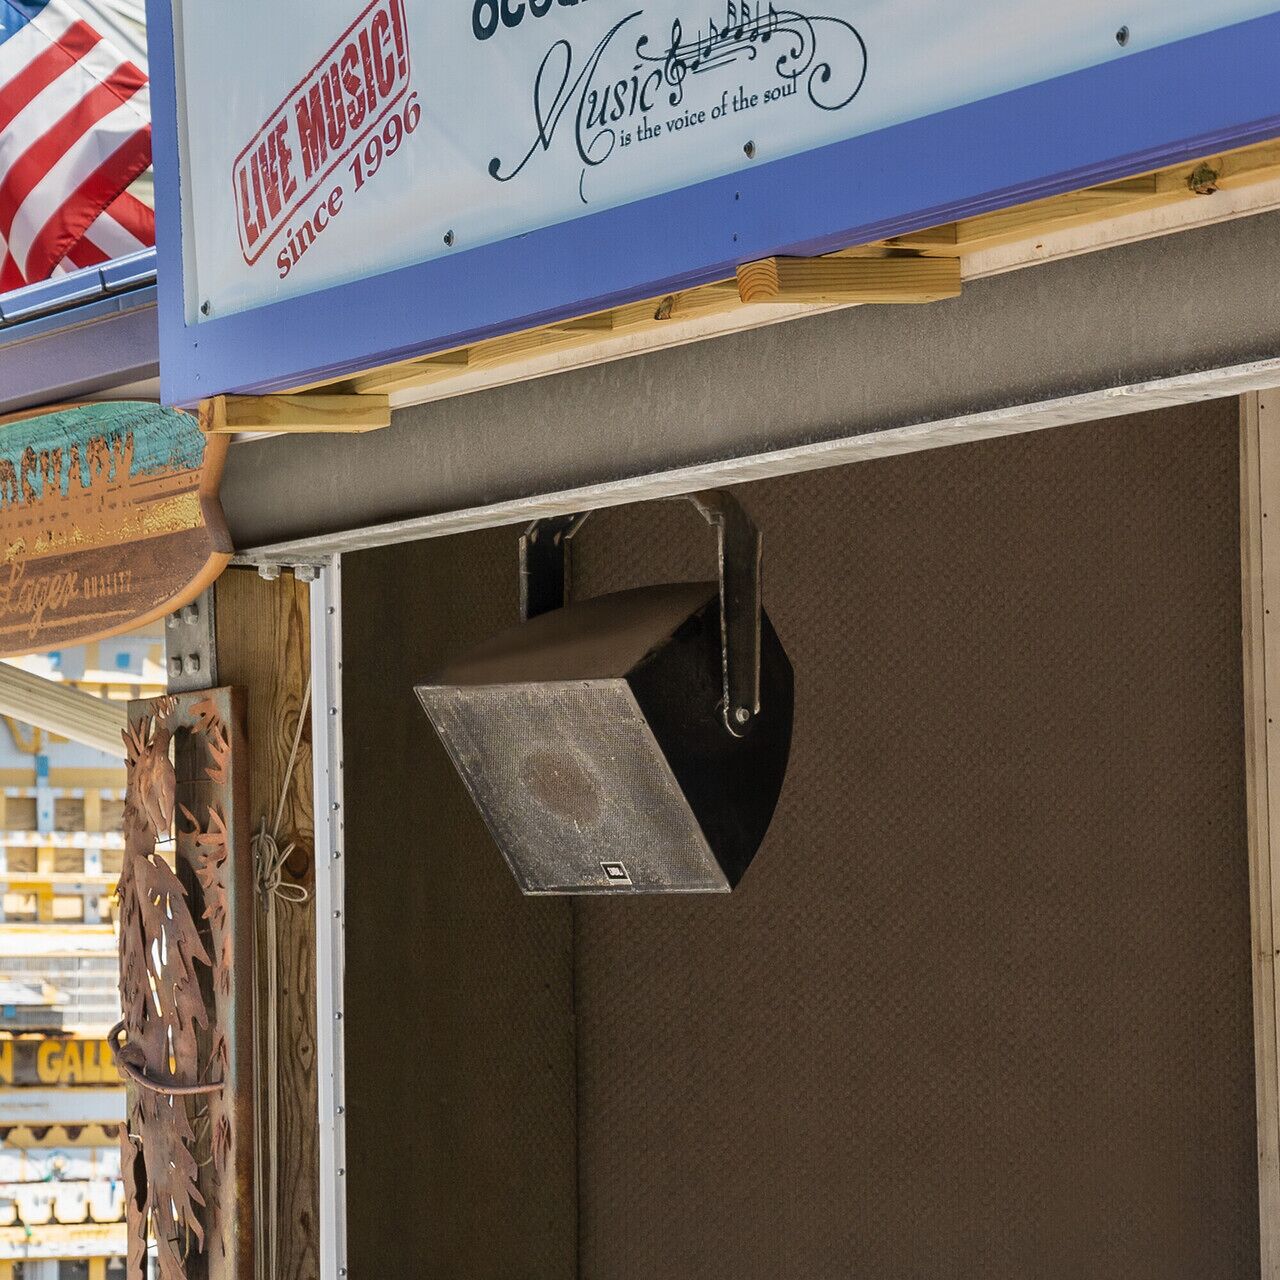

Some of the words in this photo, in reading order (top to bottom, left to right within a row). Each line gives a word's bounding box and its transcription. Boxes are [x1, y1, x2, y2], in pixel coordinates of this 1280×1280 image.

[239, 115, 297, 247] LIVE
[295, 0, 407, 182] MUSIC!
[488, 10, 664, 182] Music
[620, 131, 632, 147] is
[636, 118, 661, 141] the
[666, 109, 706, 134] voice
[711, 101, 728, 120] of
[732, 87, 758, 111] the
[763, 69, 797, 103] soul
[276, 186, 343, 279] since
[349, 91, 421, 193] 1996
[83, 571, 132, 599] QUALITY
